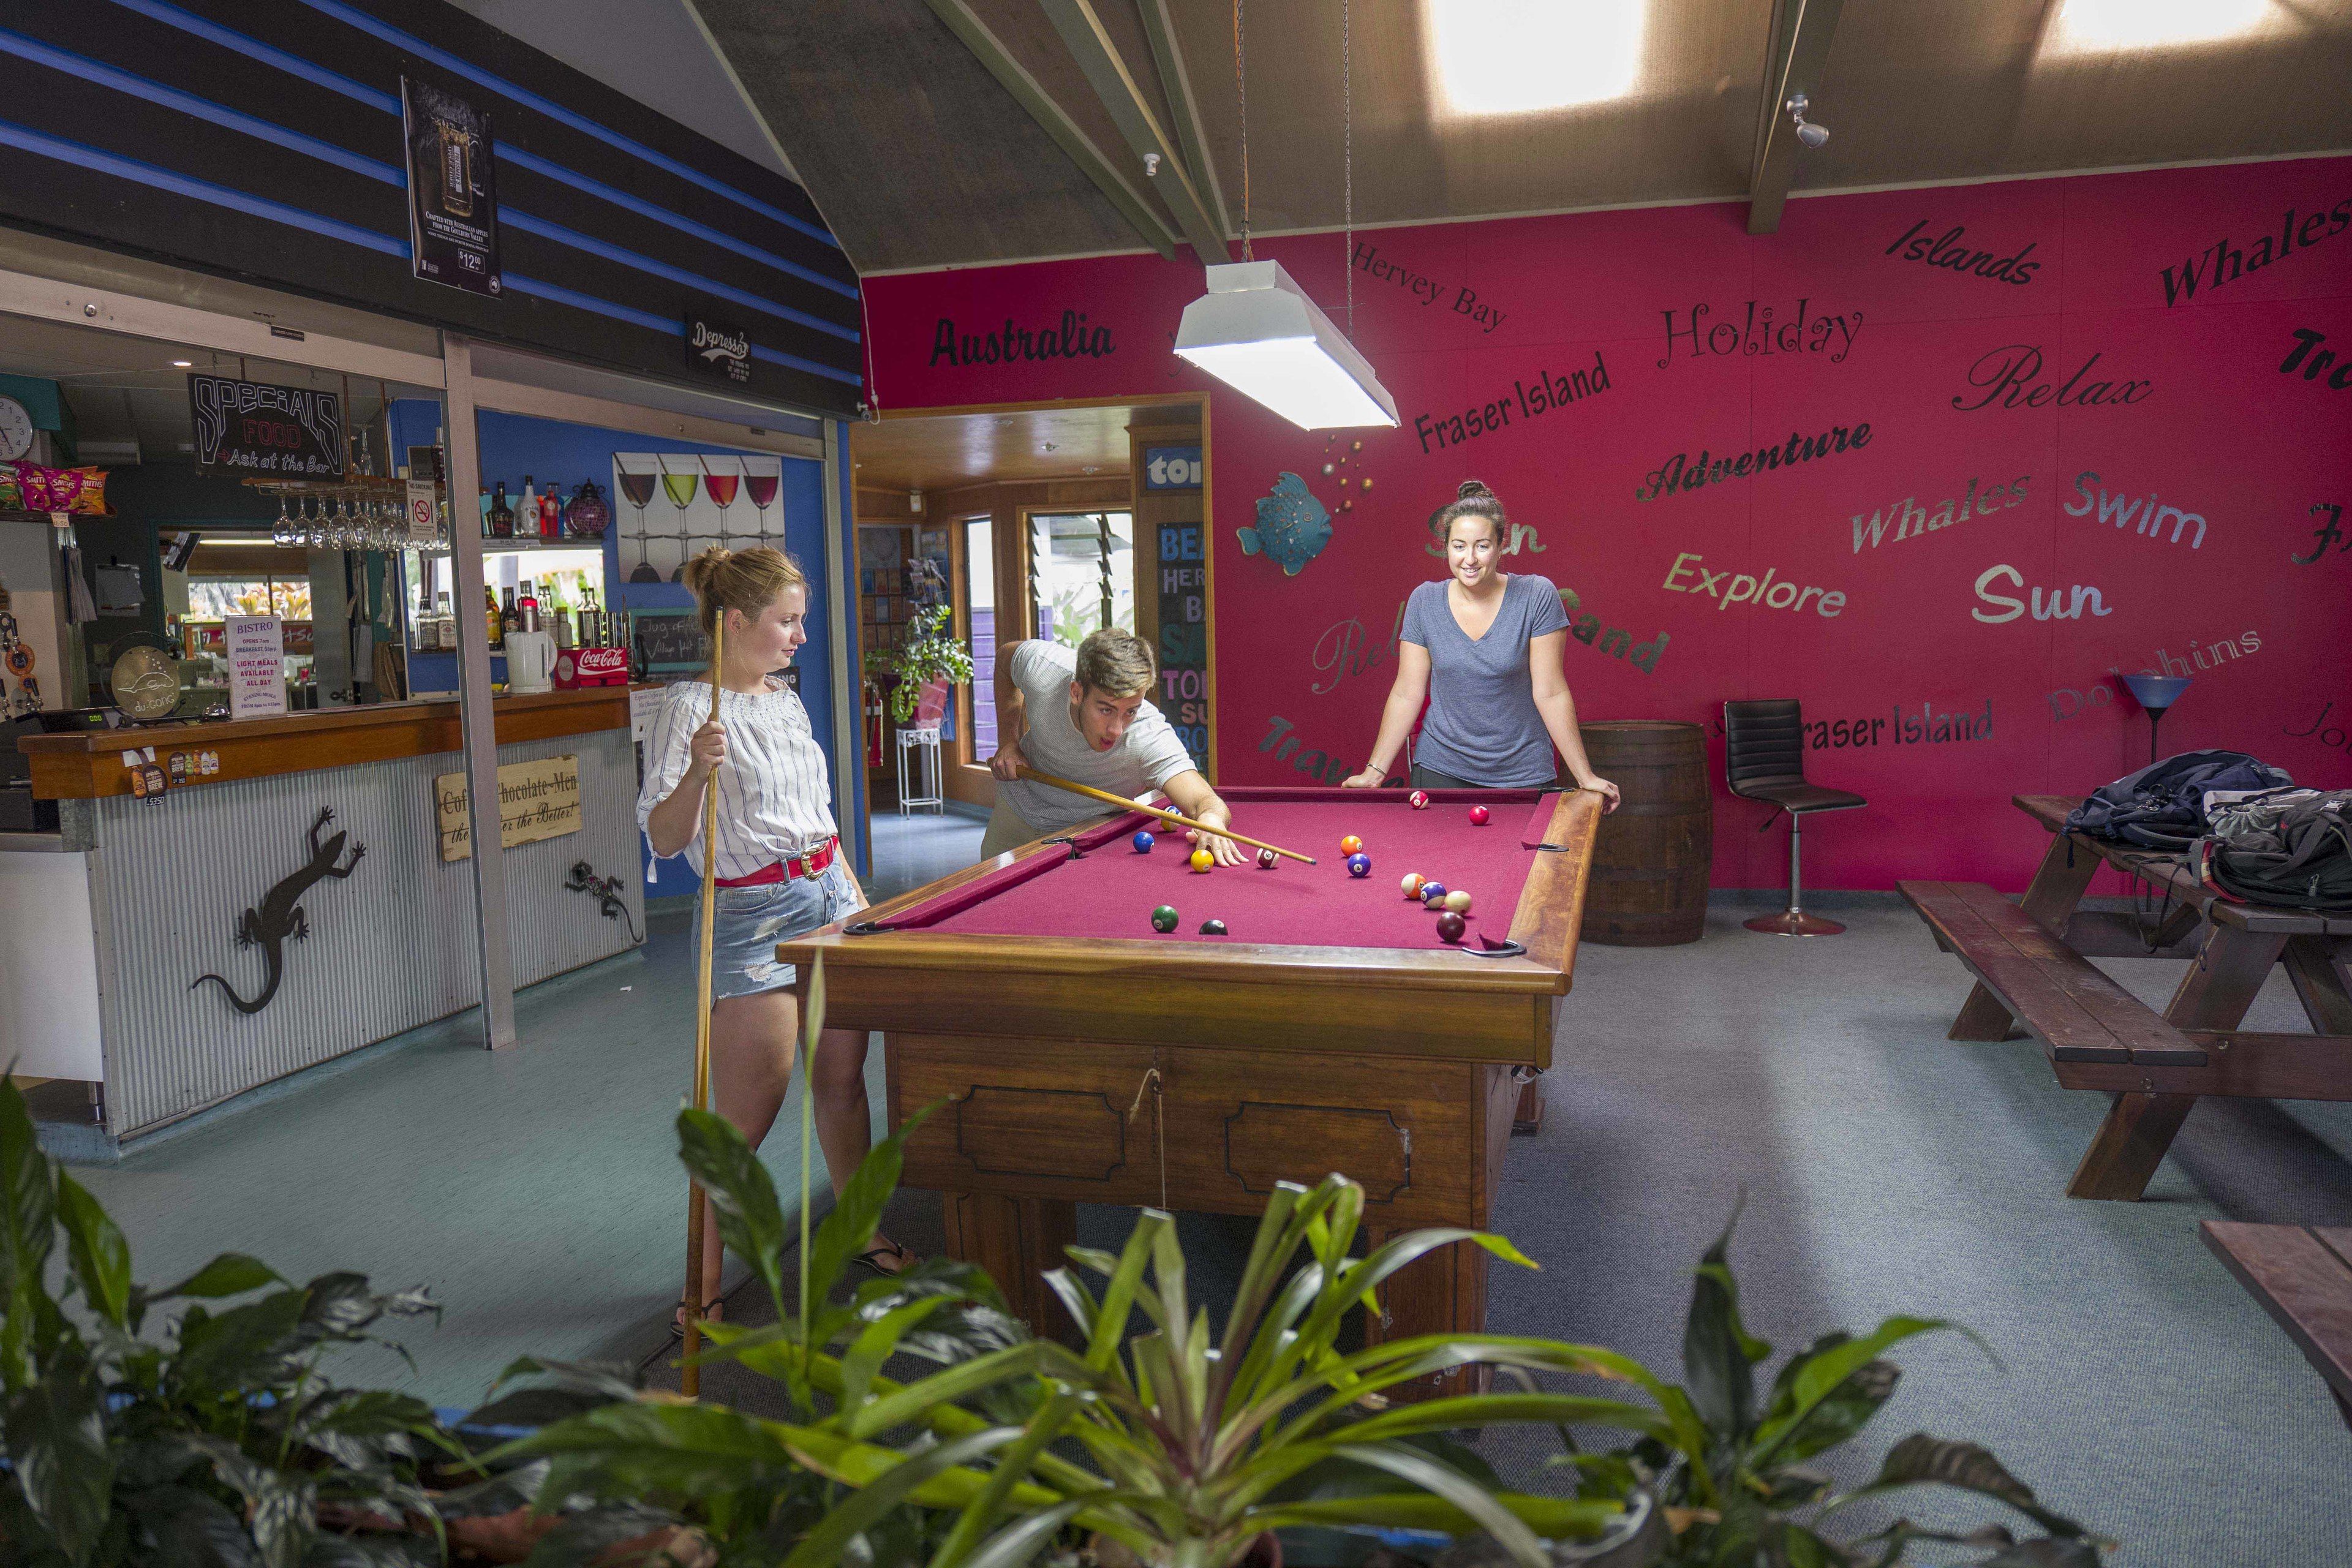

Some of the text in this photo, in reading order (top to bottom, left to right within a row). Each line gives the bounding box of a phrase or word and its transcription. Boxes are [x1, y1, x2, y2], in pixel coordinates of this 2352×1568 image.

[1885, 219, 2041, 285] Islands
[2159, 198, 2352, 308] Whales
[1351, 242, 1509, 333] Hervey Bay
[929, 309, 1116, 367] Australia
[1657, 298, 1863, 369] Holiday
[1415, 351, 1611, 454] Fraser Island
[1952, 344, 2154, 411] Relax
[227, 449, 330, 473] Ask at the Bar
[243, 419, 301, 448] FOOD
[1636, 423, 1873, 502] Adventure
[1849, 475, 2031, 555] Whales
[2064, 471, 2206, 549] Swim
[1161, 528, 1205, 561] BE
[1662, 552, 1846, 617] Explore
[1972, 564, 2112, 624] Sun
[237, 622, 273, 635] BISTRO
[579, 649, 624, 668] Coca-Cola
[2045, 630, 2263, 722] Dolhins
[1802, 698, 1993, 750] raser Island
[517, 809, 532, 829] the
